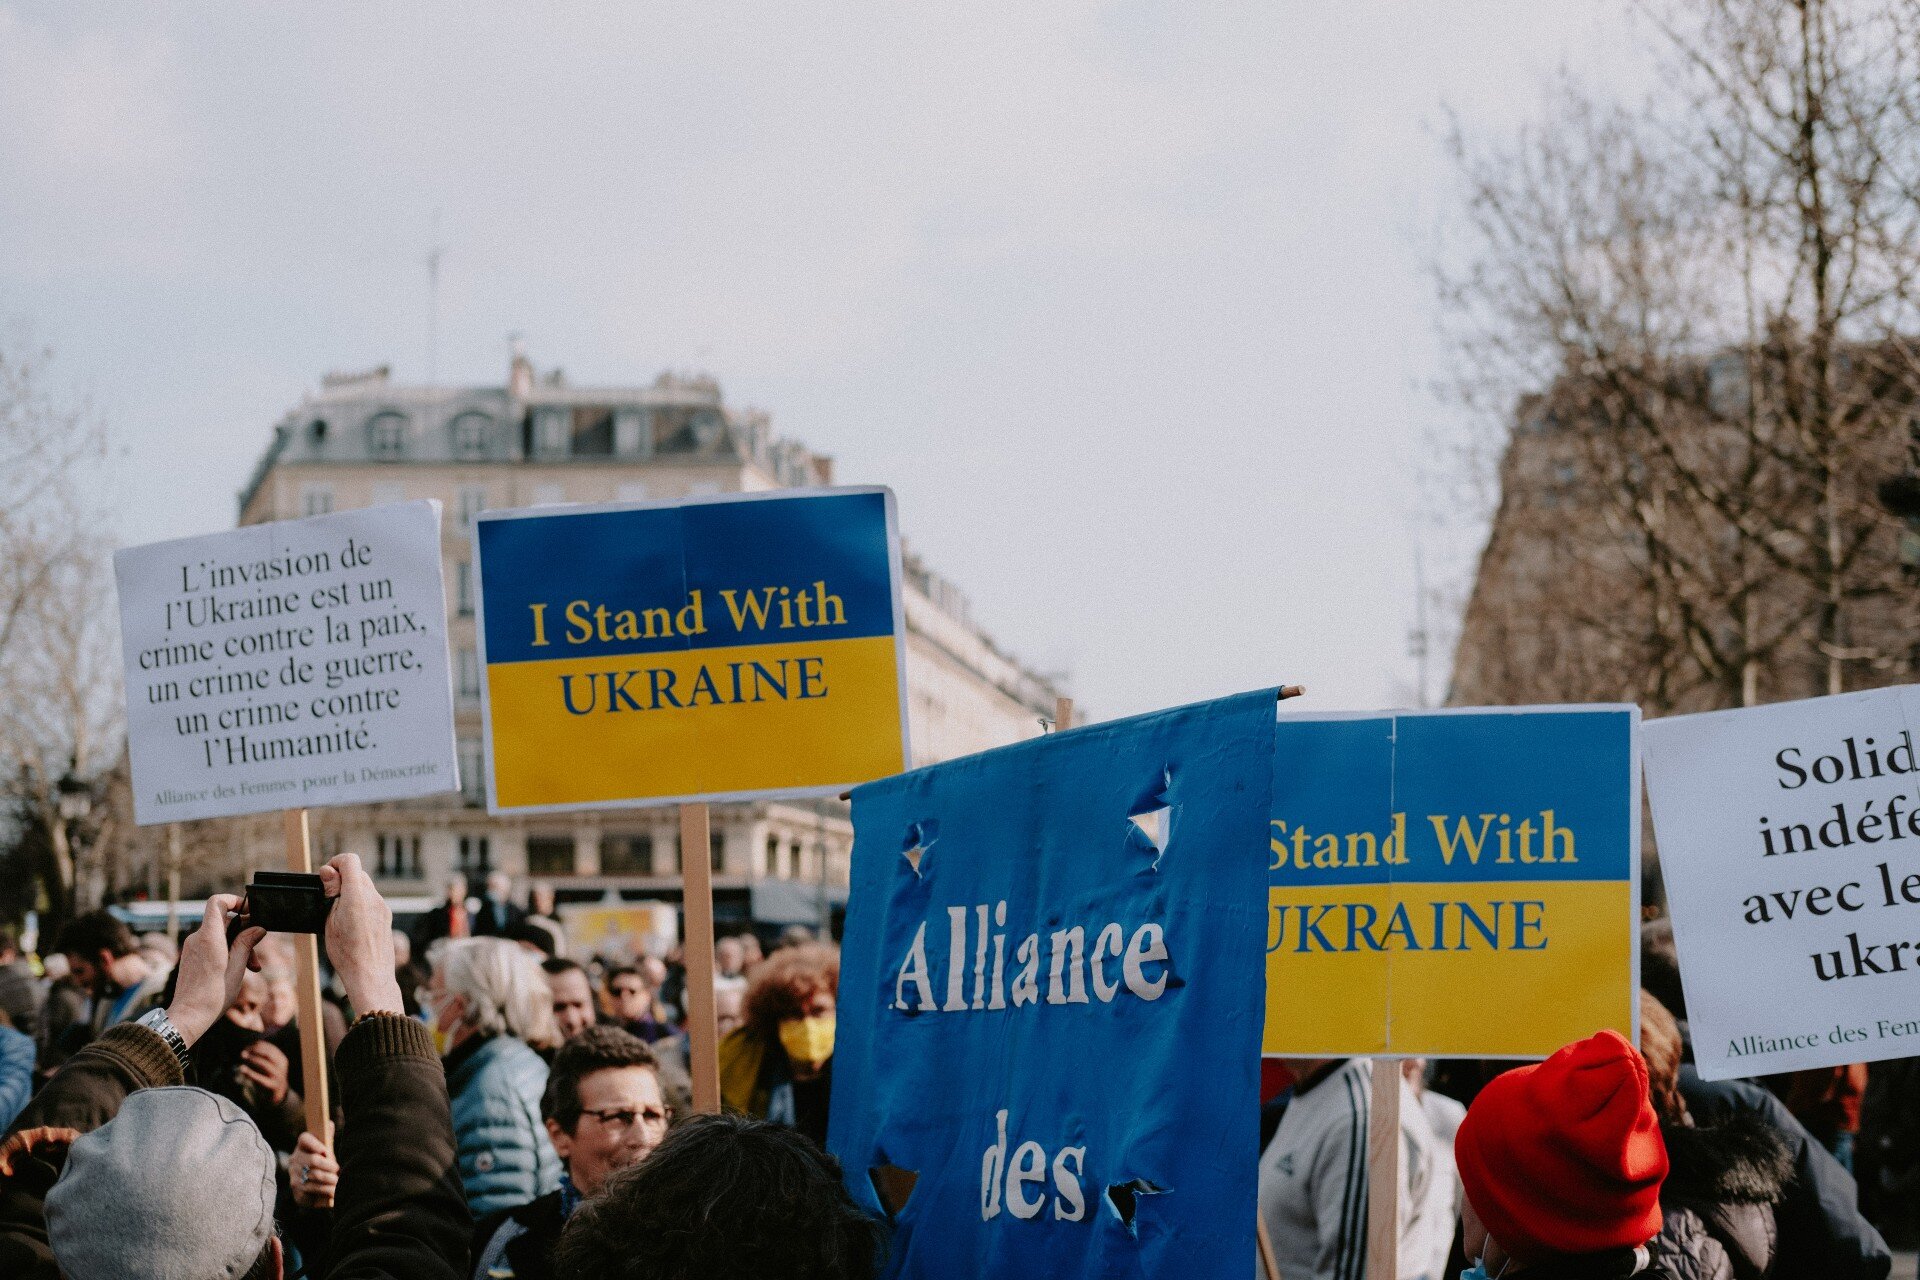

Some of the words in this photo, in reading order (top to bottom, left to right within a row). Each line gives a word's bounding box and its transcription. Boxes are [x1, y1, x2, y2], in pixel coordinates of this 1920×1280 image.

[340, 538, 373, 566] de
[311, 582, 350, 606] est
[360, 577, 393, 601] un
[529, 603, 549, 646] I
[566, 590, 707, 644] Stand
[719, 581, 847, 632] With
[139, 638, 215, 670] crime
[224, 625, 314, 659] contre
[326, 615, 349, 644] la
[361, 605, 427, 647] paix,
[148, 679, 180, 704] un
[189, 665, 270, 698] crime
[279, 658, 314, 686] de
[325, 651, 423, 688] guerre,
[559, 657, 829, 715] UKRAINE
[176, 712, 208, 736] un
[218, 697, 299, 730] crime
[311, 687, 401, 718] contre
[153, 786, 207, 807] Alliance
[213, 784, 236, 799] des
[240, 778, 297, 795] Femmes
[302, 775, 338, 792] pour
[343, 769, 356, 783] la
[361, 761, 439, 780] Démocratie
[1775, 730, 1920, 790] Solid
[1269, 812, 1409, 870] Stand
[1428, 809, 1579, 866] With
[1742, 880, 1864, 925] avec
[1876, 862, 1920, 907] le
[889, 899, 1169, 1012] Alliance
[1810, 932, 1920, 982] ukr
[1726, 1030, 1819, 1058] Alliance
[1828, 1025, 1868, 1045] des
[980, 1108, 1086, 1222] des
